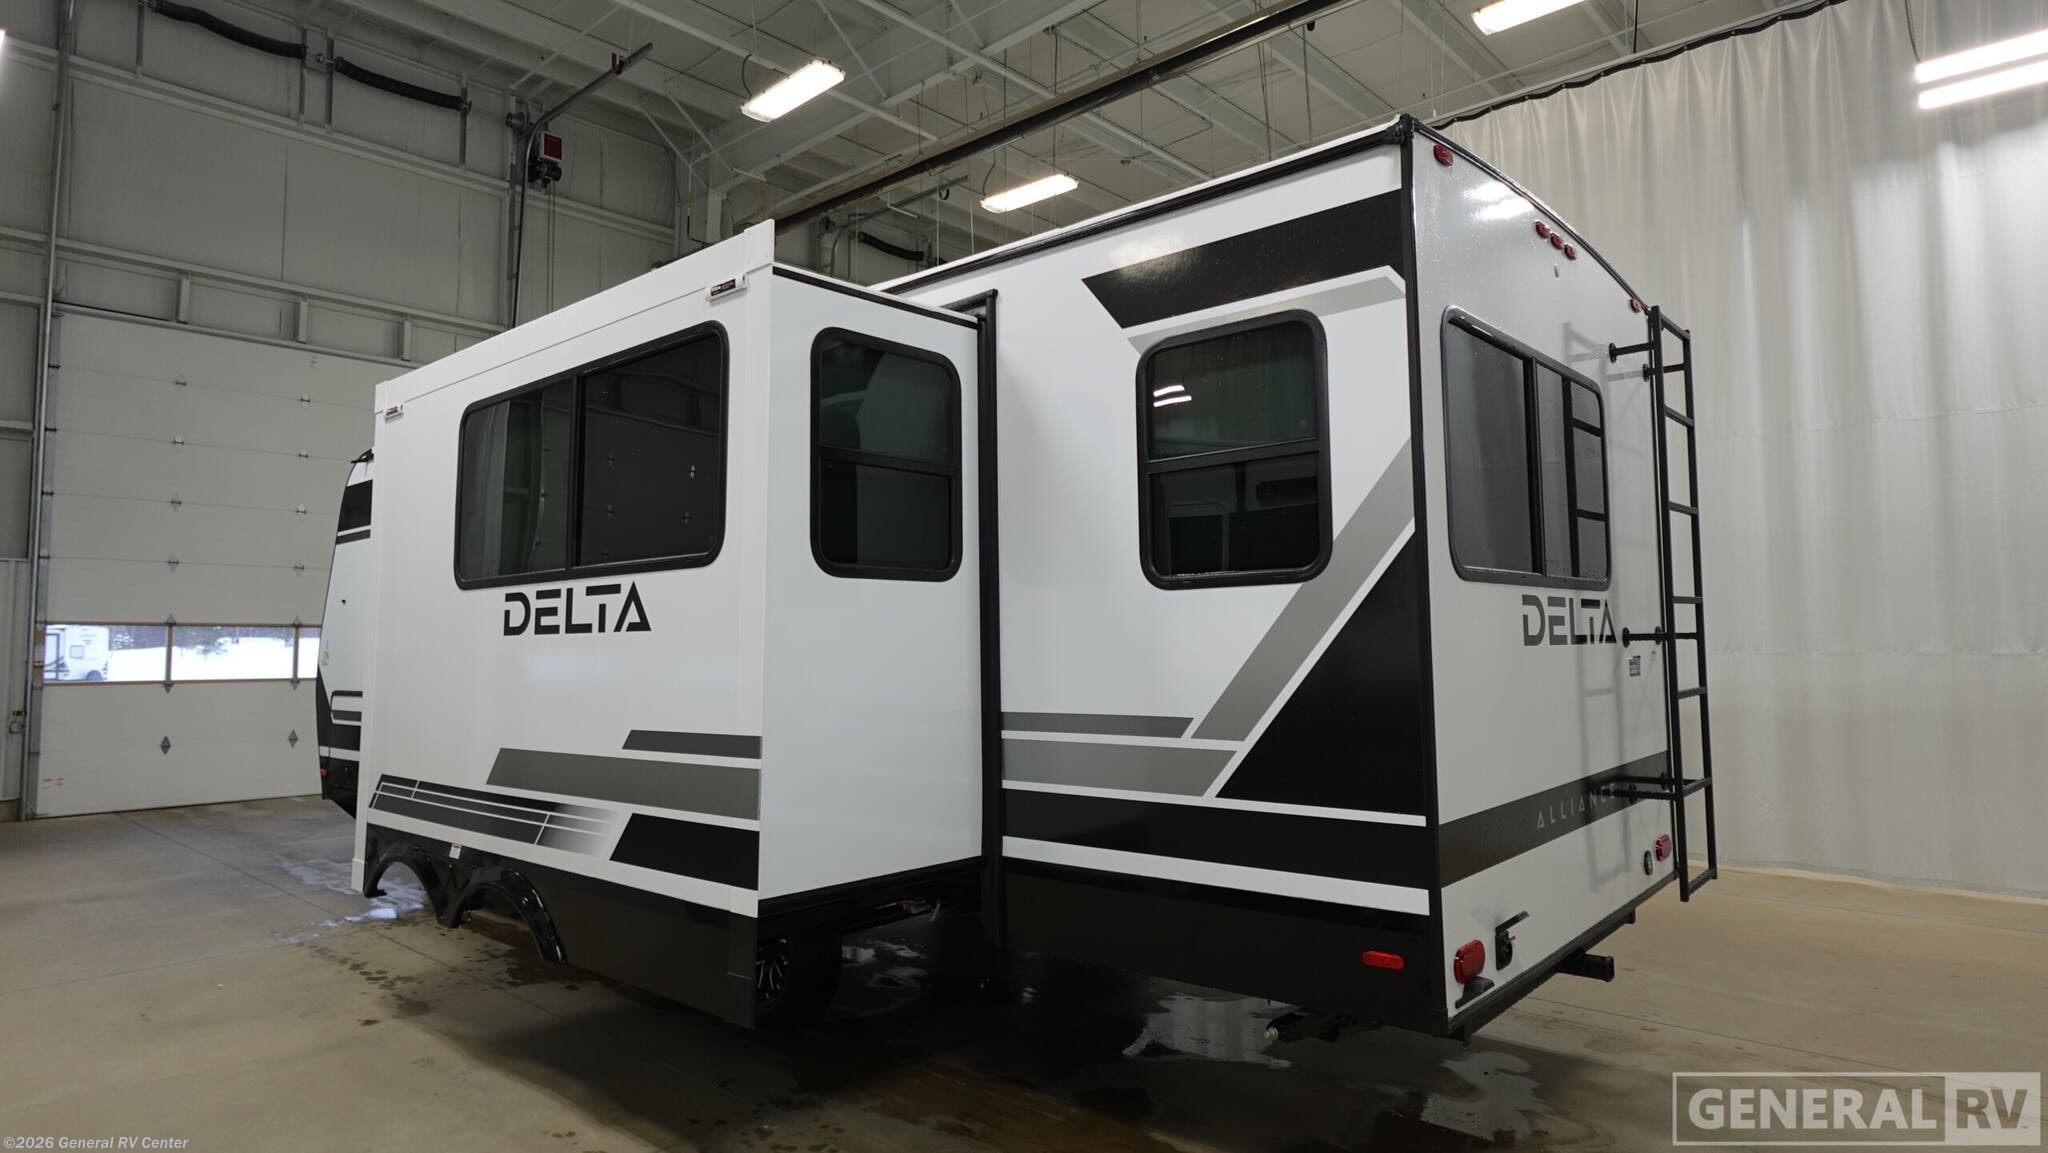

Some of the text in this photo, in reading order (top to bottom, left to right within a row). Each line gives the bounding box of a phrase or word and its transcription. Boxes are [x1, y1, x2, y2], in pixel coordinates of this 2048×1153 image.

[504, 581, 652, 636] DELTA
[1522, 594, 1617, 646] DELTA
[1537, 782, 1616, 829] ALLIANCE
